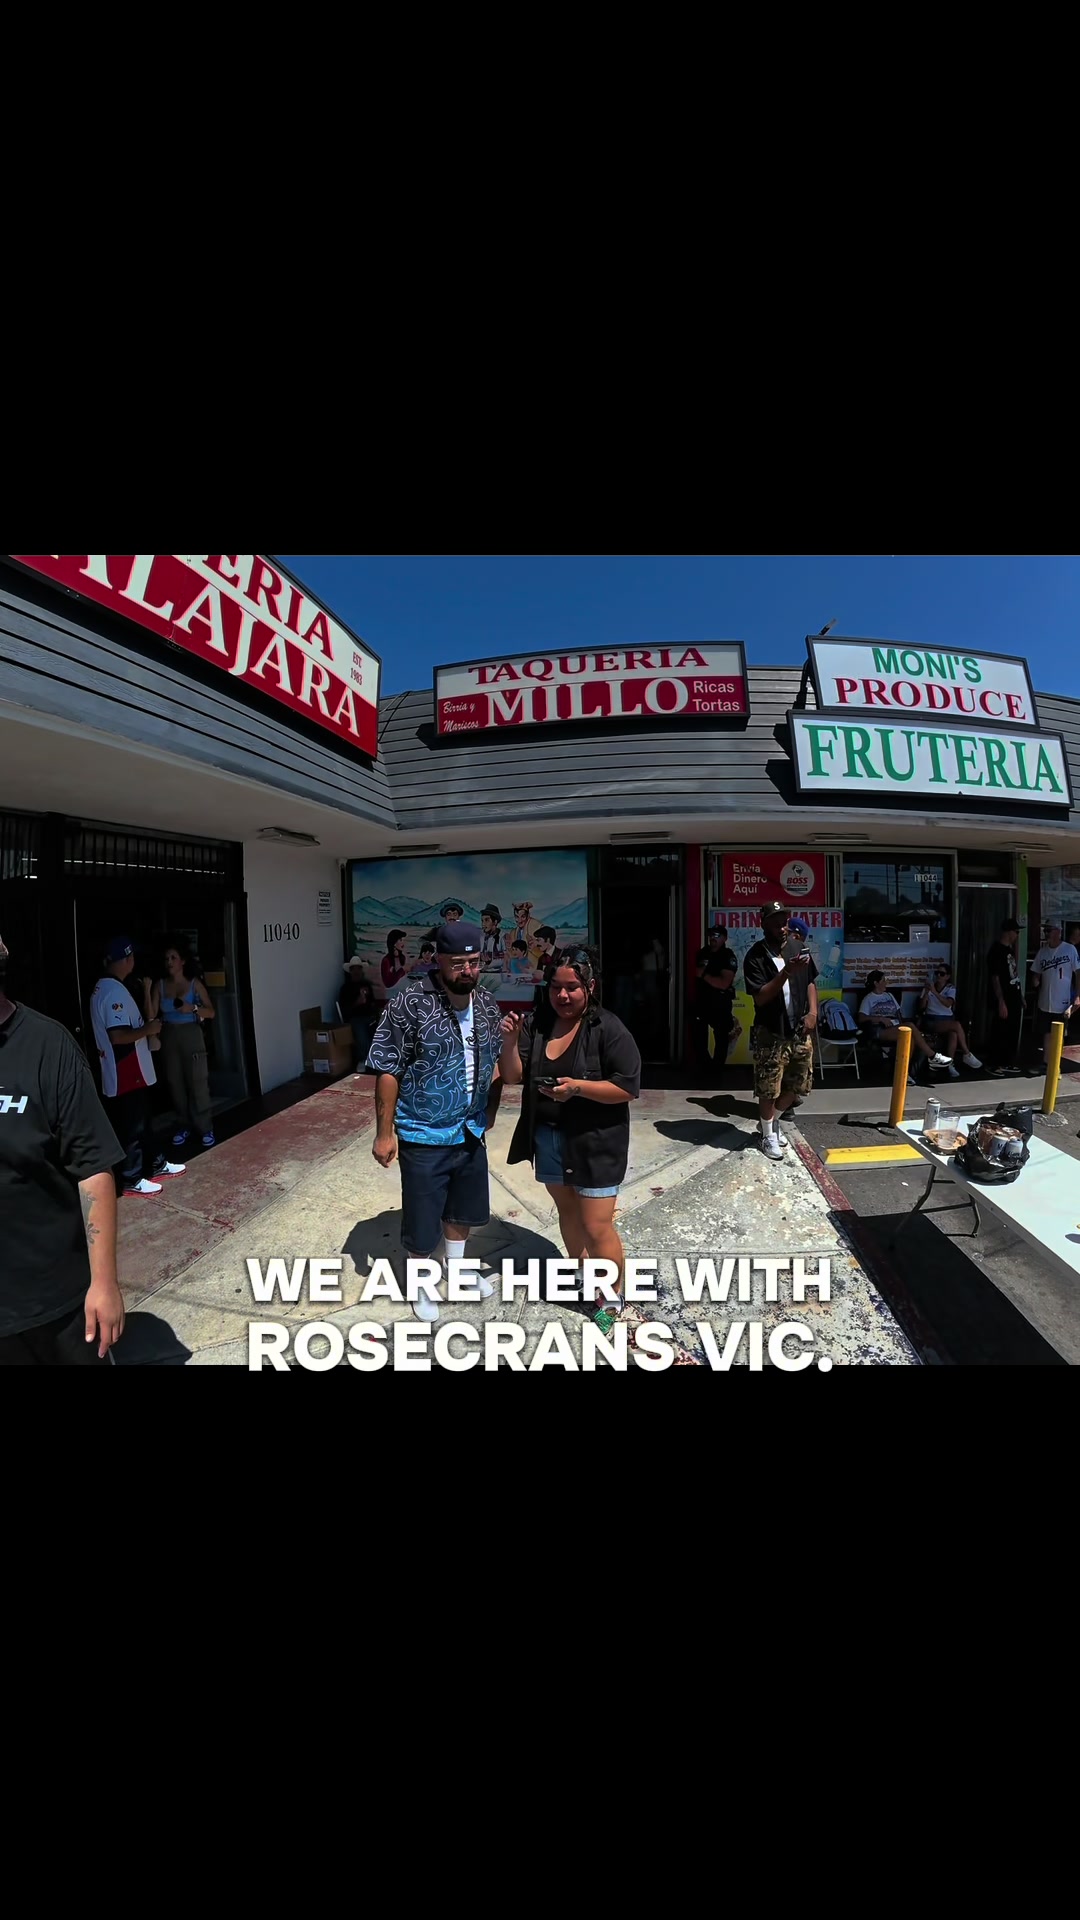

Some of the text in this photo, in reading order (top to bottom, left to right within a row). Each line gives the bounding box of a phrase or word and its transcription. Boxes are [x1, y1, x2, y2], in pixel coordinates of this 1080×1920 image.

[468, 647, 709, 685] TAQUERIA
[871, 647, 982, 683] MONI'S
[350, 667, 363, 686] 1983
[693, 680, 735, 693] Ricas
[484, 677, 690, 727] MILLO
[692, 698, 740, 711] Tortas
[832, 677, 1026, 720] PRODUCE
[469, 702, 476, 713] y
[443, 719, 479, 732] Mariscos
[801, 723, 1064, 794] FRUTERIA
[732, 863, 761, 873] Envía
[733, 874, 768, 883] Dinero
[786, 877, 808, 885] BOSS
[733, 884, 758, 896] Aquí
[773, 901, 781, 910] S
[263, 922, 300, 943] 11040
[1040, 954, 1071, 970] Dodgers
[1058, 966, 1063, 980] 1
